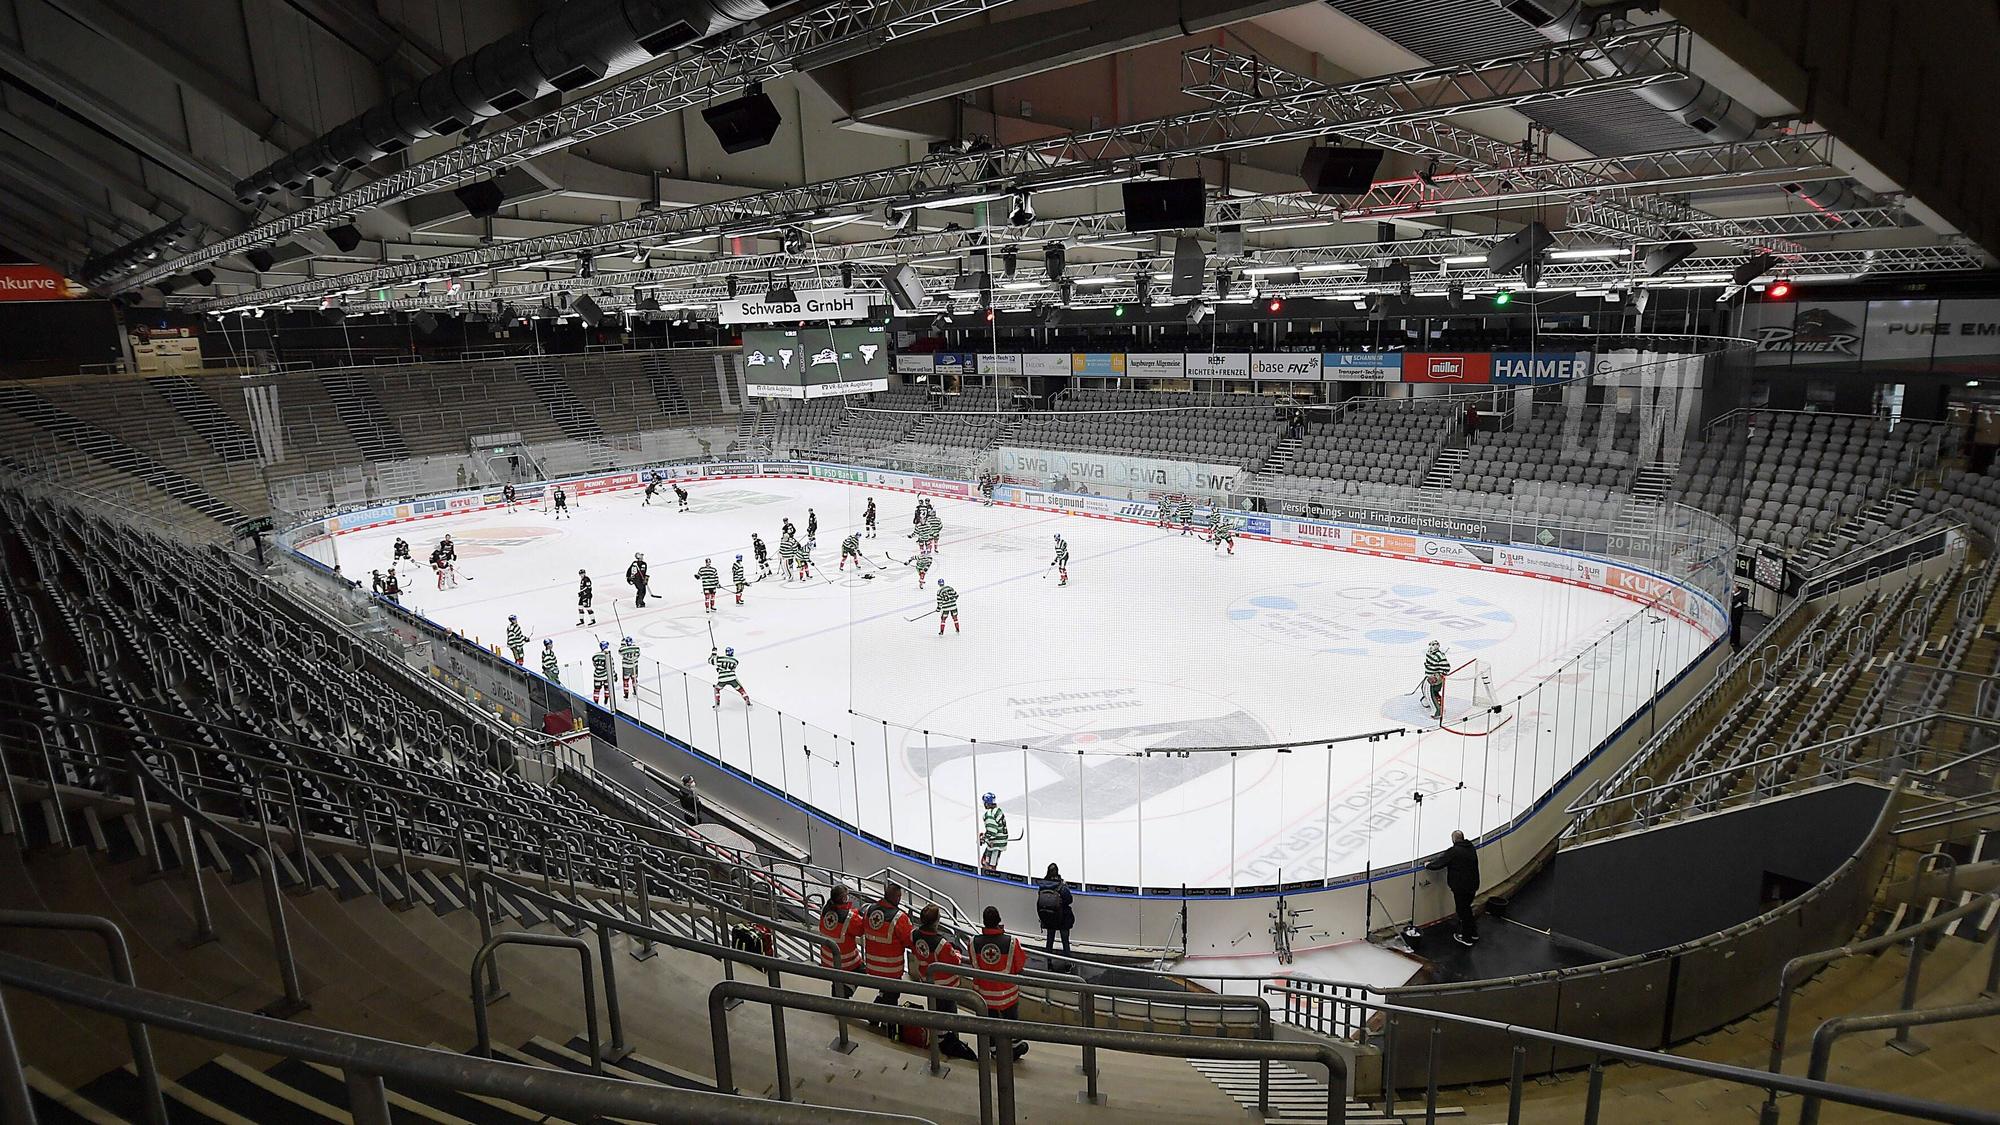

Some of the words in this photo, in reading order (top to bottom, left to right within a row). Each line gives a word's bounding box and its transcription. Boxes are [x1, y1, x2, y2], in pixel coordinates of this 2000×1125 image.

[741, 302, 801, 315] Schwaba
[806, 299, 854, 312] GmbH
[1888, 323, 1951, 336] PURE
[1252, 360, 1284, 373] ebase
[1431, 361, 1460, 374] müller
[1495, 359, 1587, 378] HAIMER
[1017, 455, 1048, 472] swa
[1071, 460, 1104, 479] swa
[1129, 466, 1167, 486] swa
[1195, 471, 1235, 492] swa
[1048, 495, 1084, 509] siegmund
[1281, 502, 1345, 519] Versicherungs-
[1348, 510, 1366, 520] und
[1370, 511, 1487, 534] Finanzdienstleistungen
